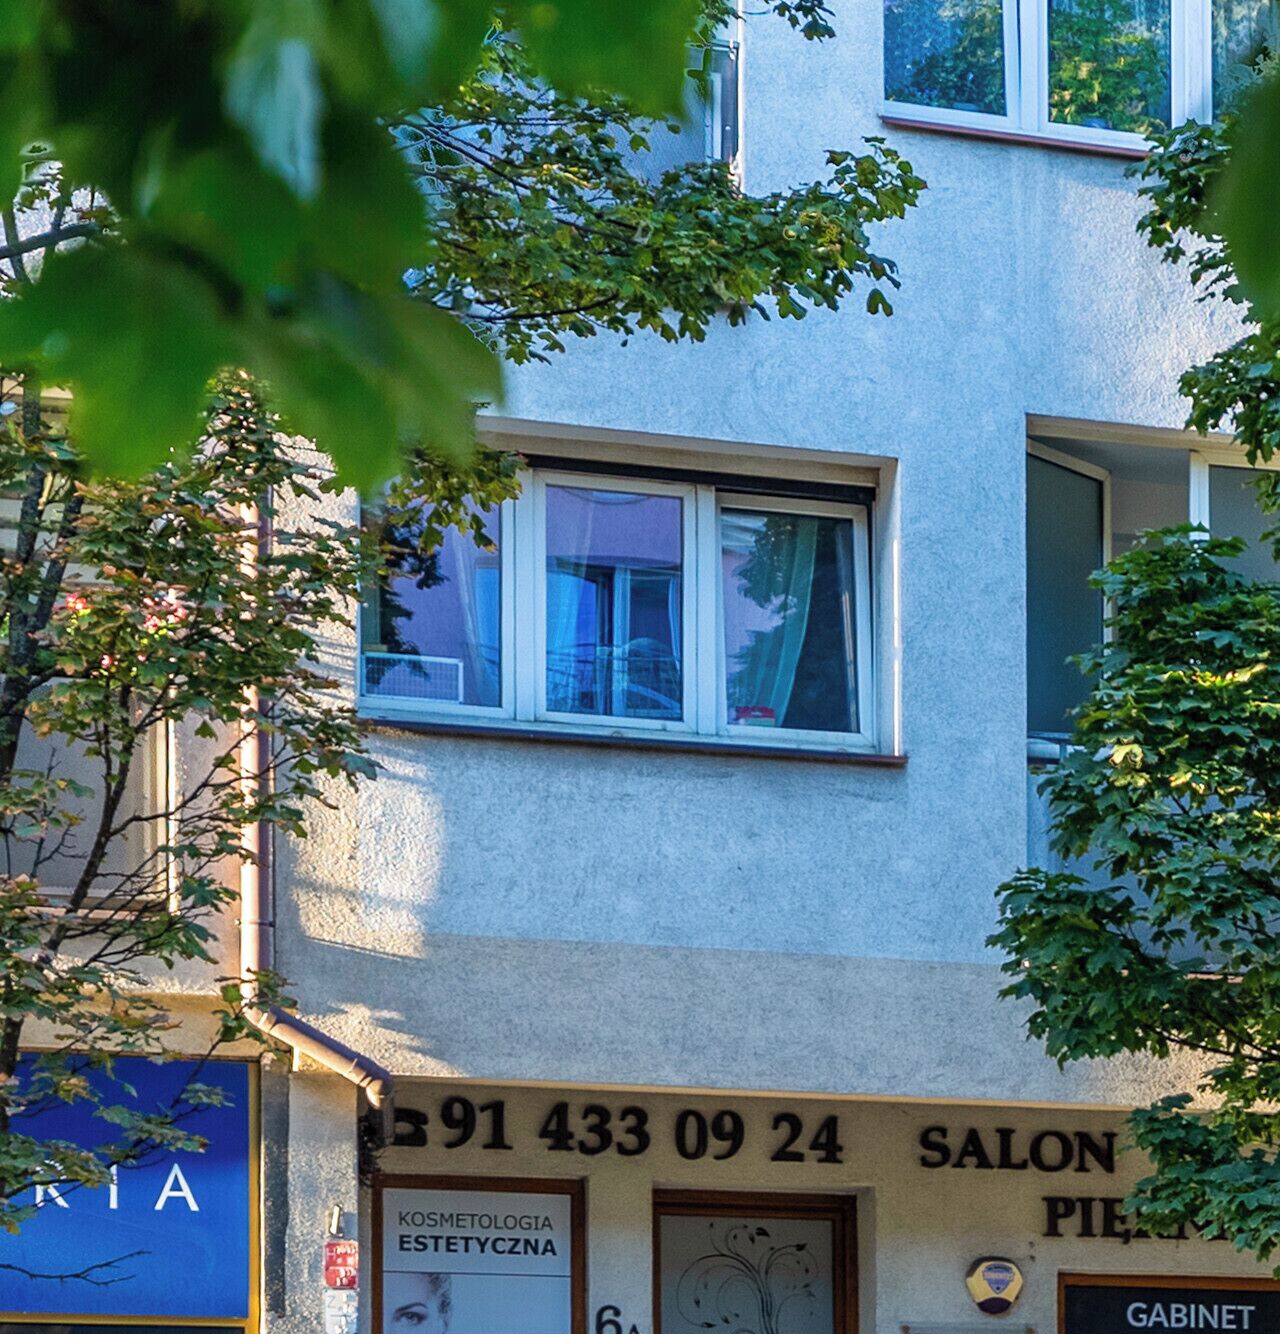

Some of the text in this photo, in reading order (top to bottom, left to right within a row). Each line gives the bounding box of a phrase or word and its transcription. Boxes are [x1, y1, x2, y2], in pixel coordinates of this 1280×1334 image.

[440, 1096, 844, 1164] 91 433 09 24
[918, 1126, 1118, 1174] SALON
[398, 1209, 554, 1232] KOSMETOLOGIA
[398, 1233, 557, 1257] ESTETYCZNA
[1126, 1301, 1256, 1330] GABINET
